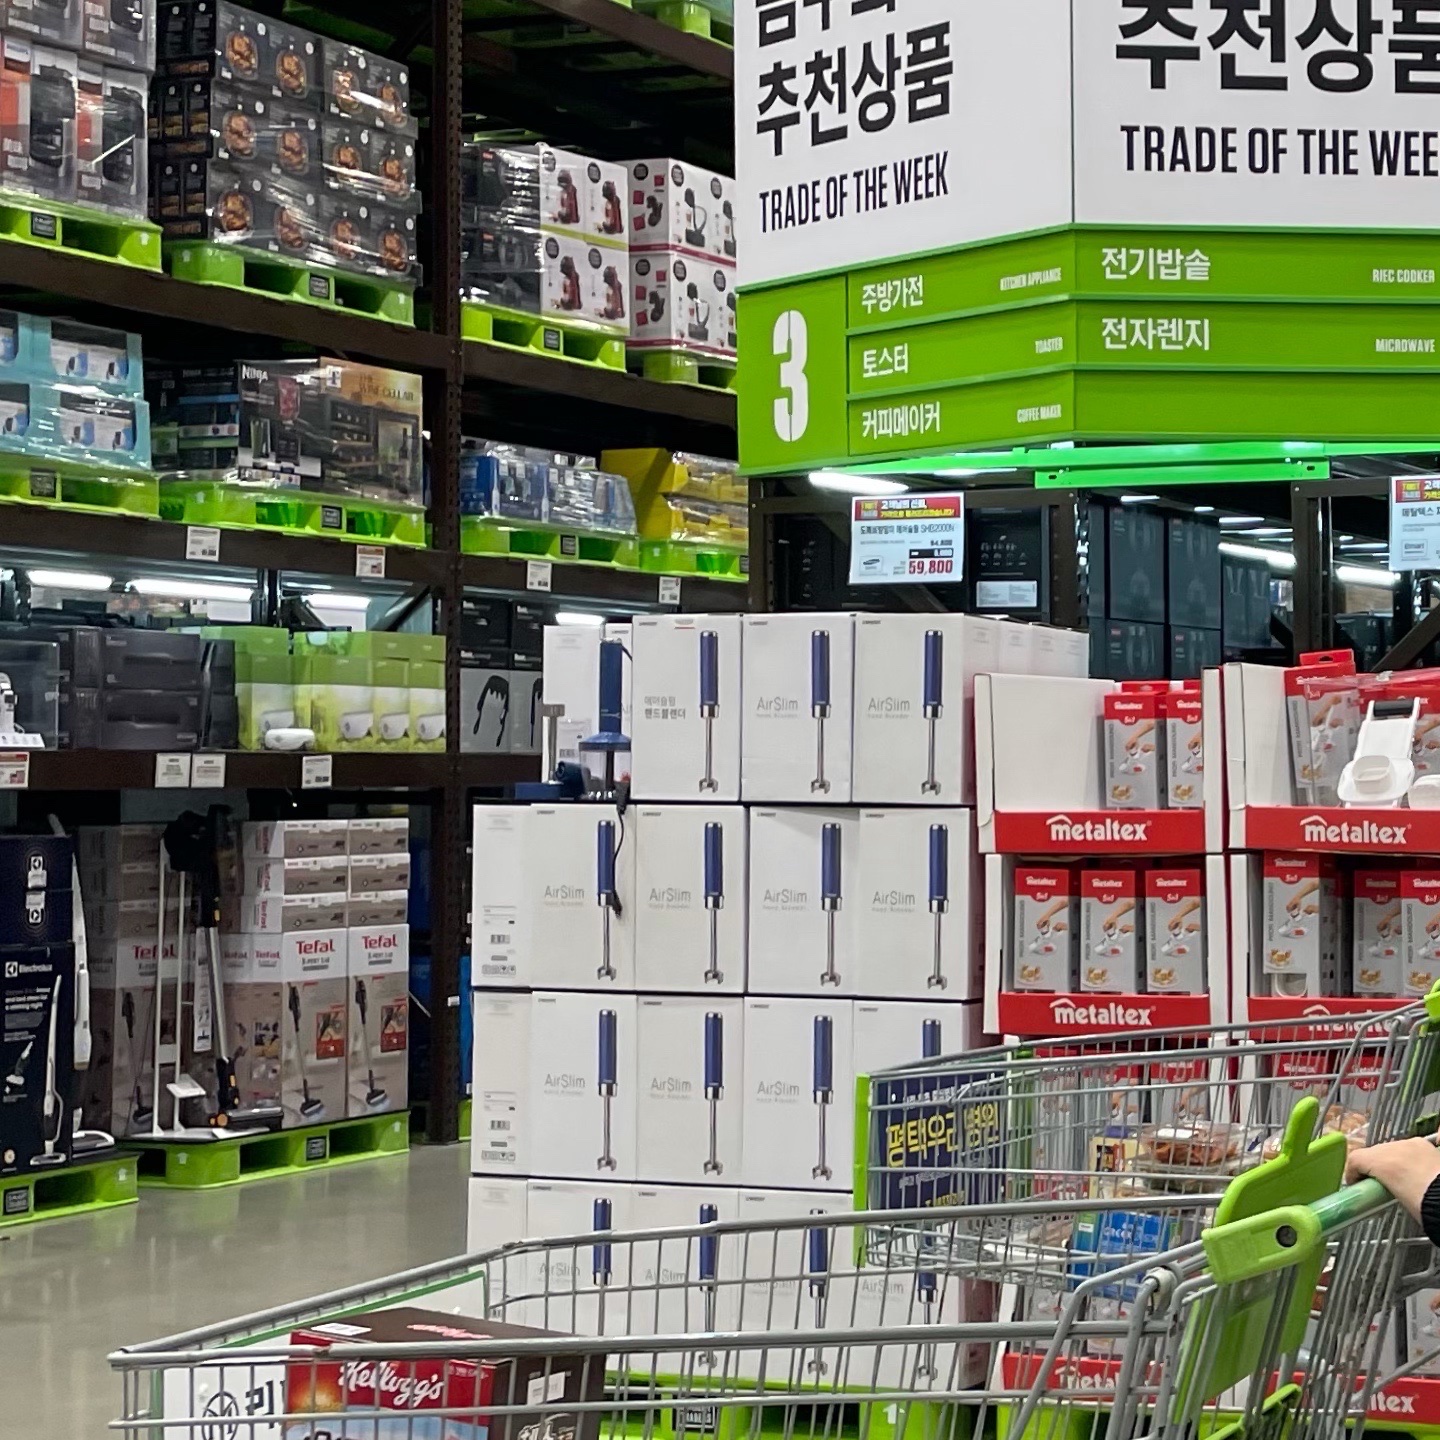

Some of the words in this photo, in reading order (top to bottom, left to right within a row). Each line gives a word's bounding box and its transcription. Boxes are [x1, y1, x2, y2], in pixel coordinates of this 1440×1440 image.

[756, 21, 953, 156] 추천상품
[1120, 124, 1237, 173] TRADE
[1248, 127, 1288, 174] OF
[1297, 129, 1358, 175] THE
[759, 180, 821, 233] TRADE
[826, 174, 848, 219] OF
[853, 165, 888, 213] THE
[893, 151, 949, 205] WEEK
[1101, 247, 1211, 281] 전기밥솥
[1396, 269, 1435, 284] COOKER
[861, 274, 924, 315] 주방가전
[1101, 317, 1211, 351] 전자렌지
[1375, 338, 1435, 354] MICROWAVE
[862, 342, 909, 379] 토스터
[773, 309, 809, 442] 3
[862, 401, 941, 440] 커피메이커
[909, 559, 953, 575] 59,800
[757, 697, 798, 712] AirSlim
[868, 697, 910, 712] AirSlim
[1046, 815, 1148, 841] metaltex
[1300, 815, 1408, 844] metaltex
[544, 885, 584, 899] AirSlim
[649, 887, 691, 902] AirSlim
[763, 889, 807, 904] AirSlim
[873, 890, 915, 906] AirSlim
[296, 938, 336, 954] Tefal
[361, 934, 398, 949] Tefal
[133, 944, 177, 959] Tefal
[1050, 998, 1152, 1026] metaltex
[544, 1073, 586, 1089] AirSlim
[651, 1077, 692, 1092] AirSlim
[757, 1080, 800, 1096] AirSlim
[338, 1360, 446, 1408] Kellogg's
